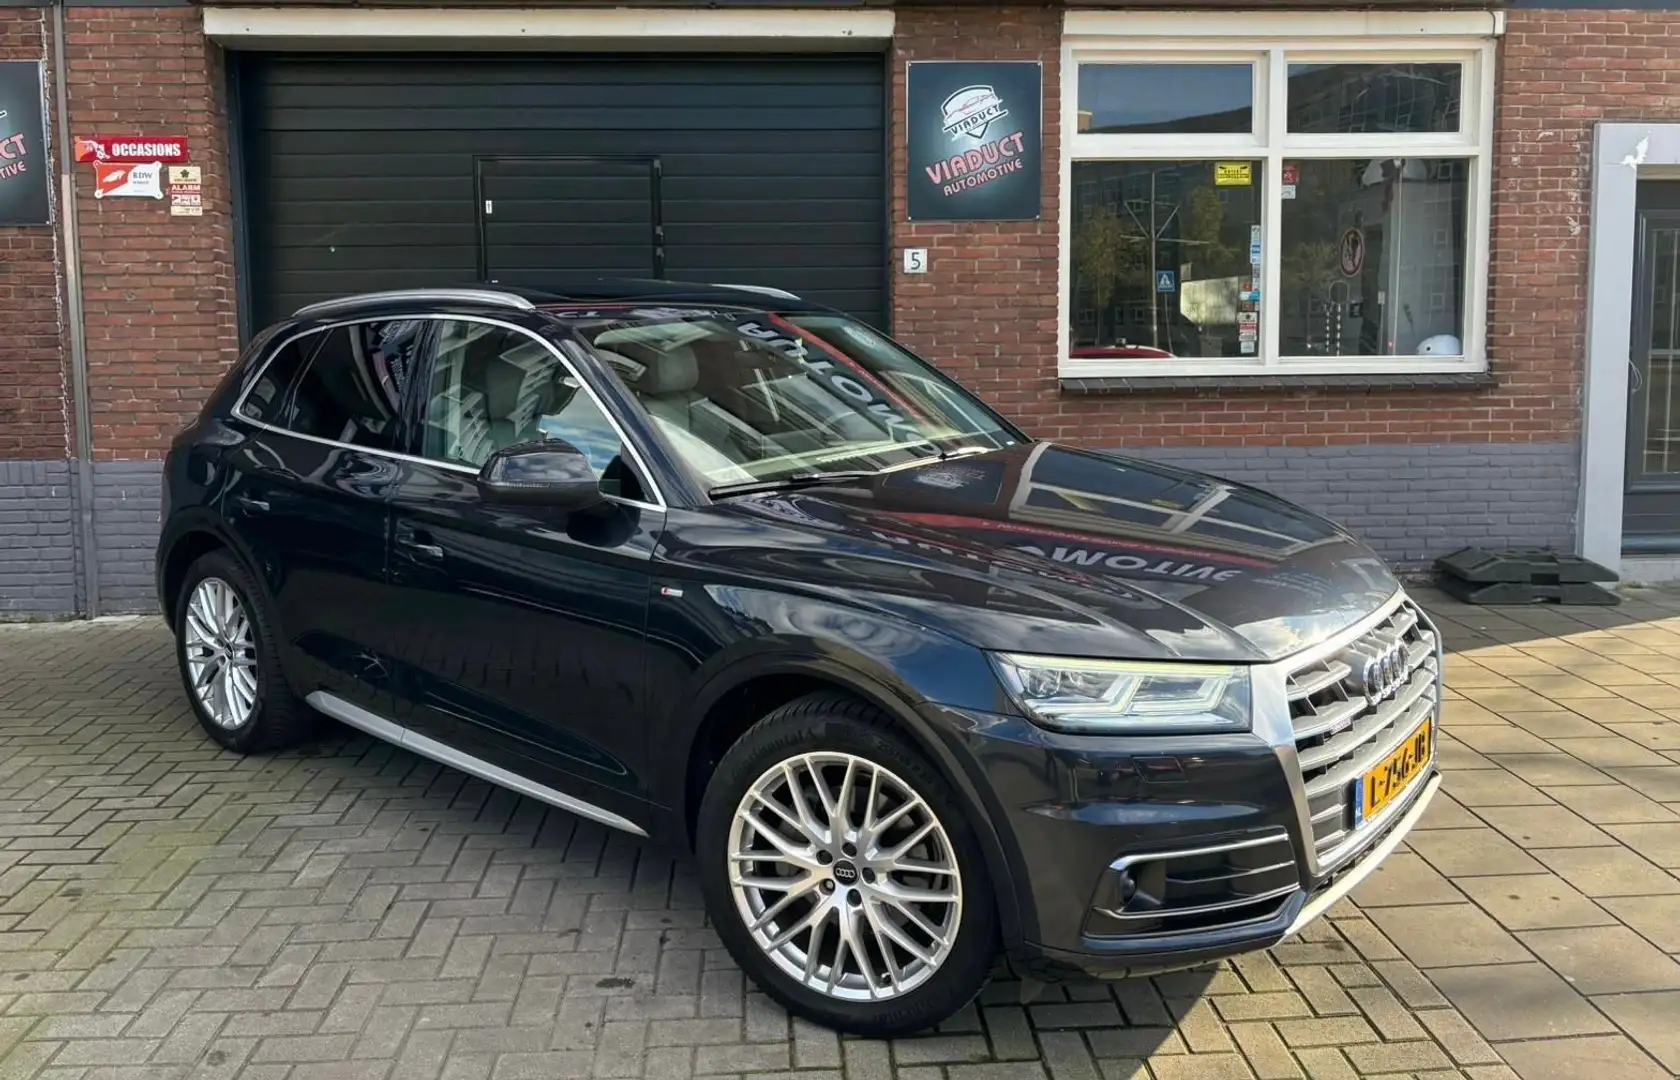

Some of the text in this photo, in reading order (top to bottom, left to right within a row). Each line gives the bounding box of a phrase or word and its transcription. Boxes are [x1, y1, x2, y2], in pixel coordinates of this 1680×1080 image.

[951, 105, 999, 134] VIADUCT
[112, 143, 181, 157] OCCASIONS
[925, 131, 1024, 185] VIADUCT
[944, 158, 1023, 196] AUTOMOTIVE
[910, 251, 921, 270] 5
